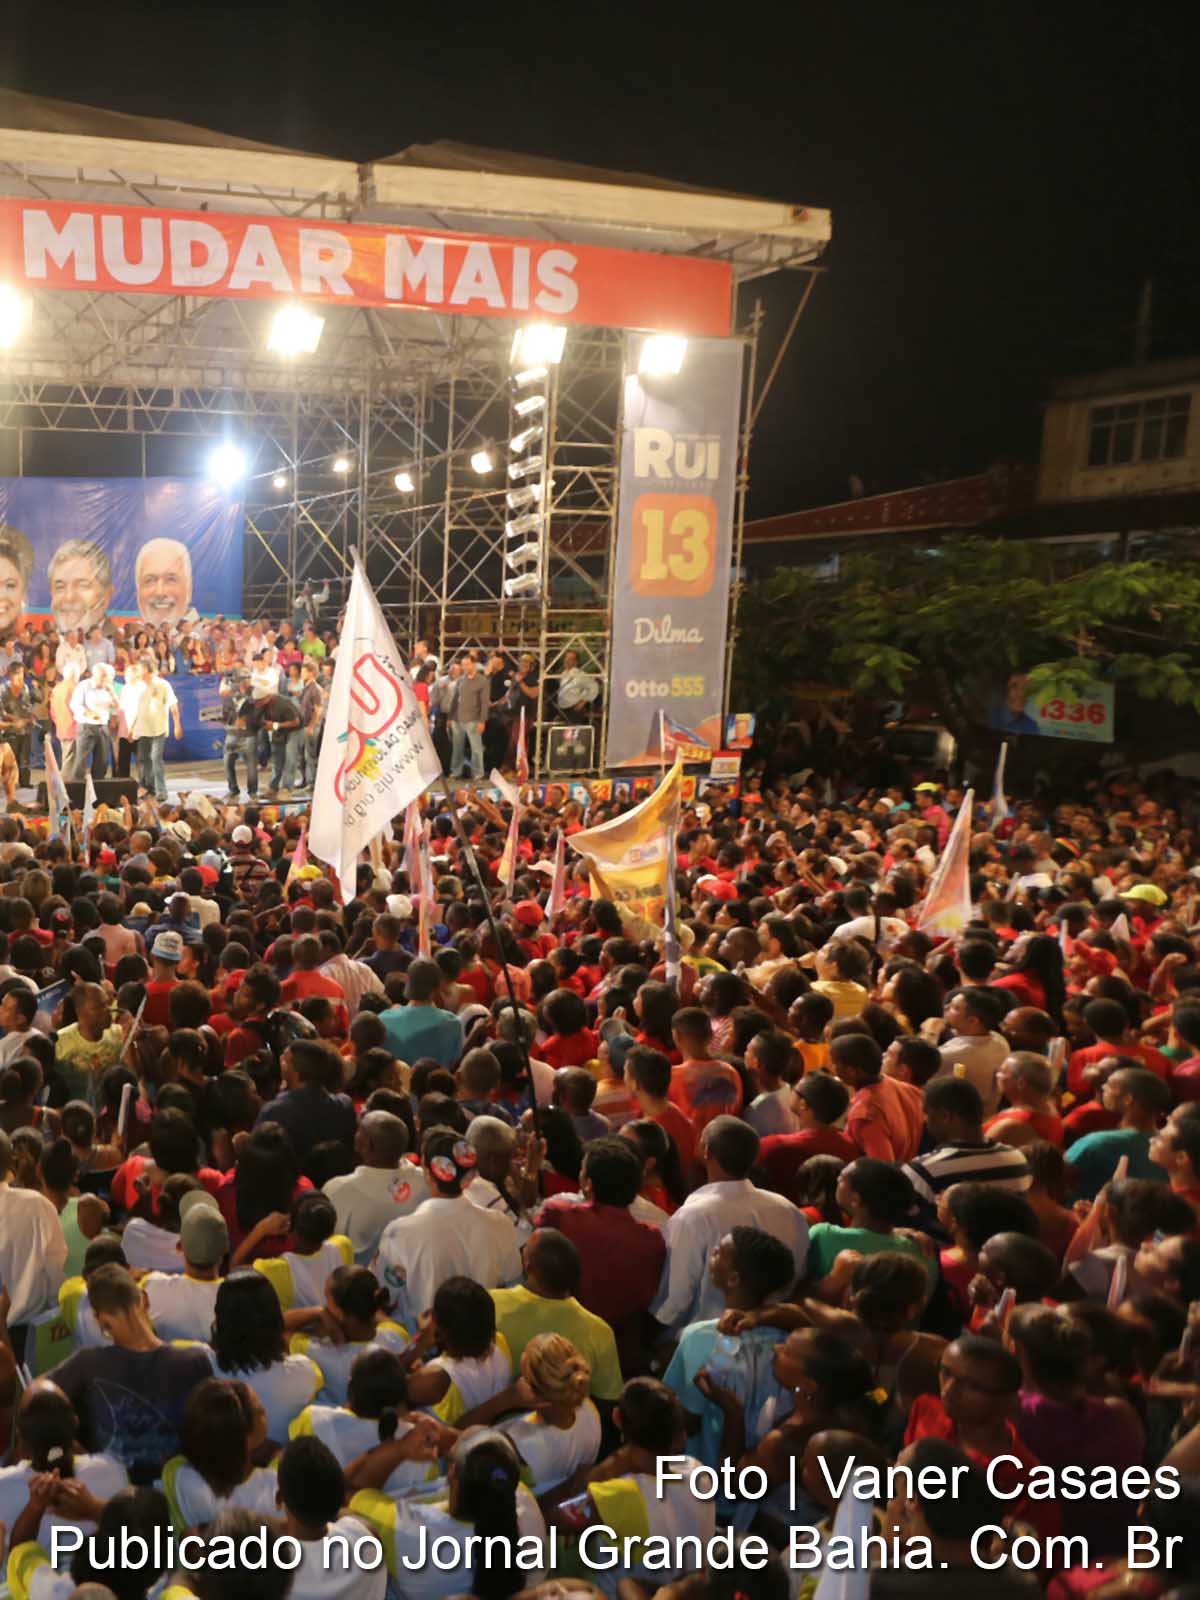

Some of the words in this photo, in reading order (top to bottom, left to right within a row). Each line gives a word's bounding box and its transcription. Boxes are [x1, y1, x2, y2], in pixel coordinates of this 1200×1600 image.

[22, 207, 356, 296] MUDAR
[384, 232, 580, 314] MAIS
[639, 508, 710, 582] 13
[632, 614, 704, 646] Dilma
